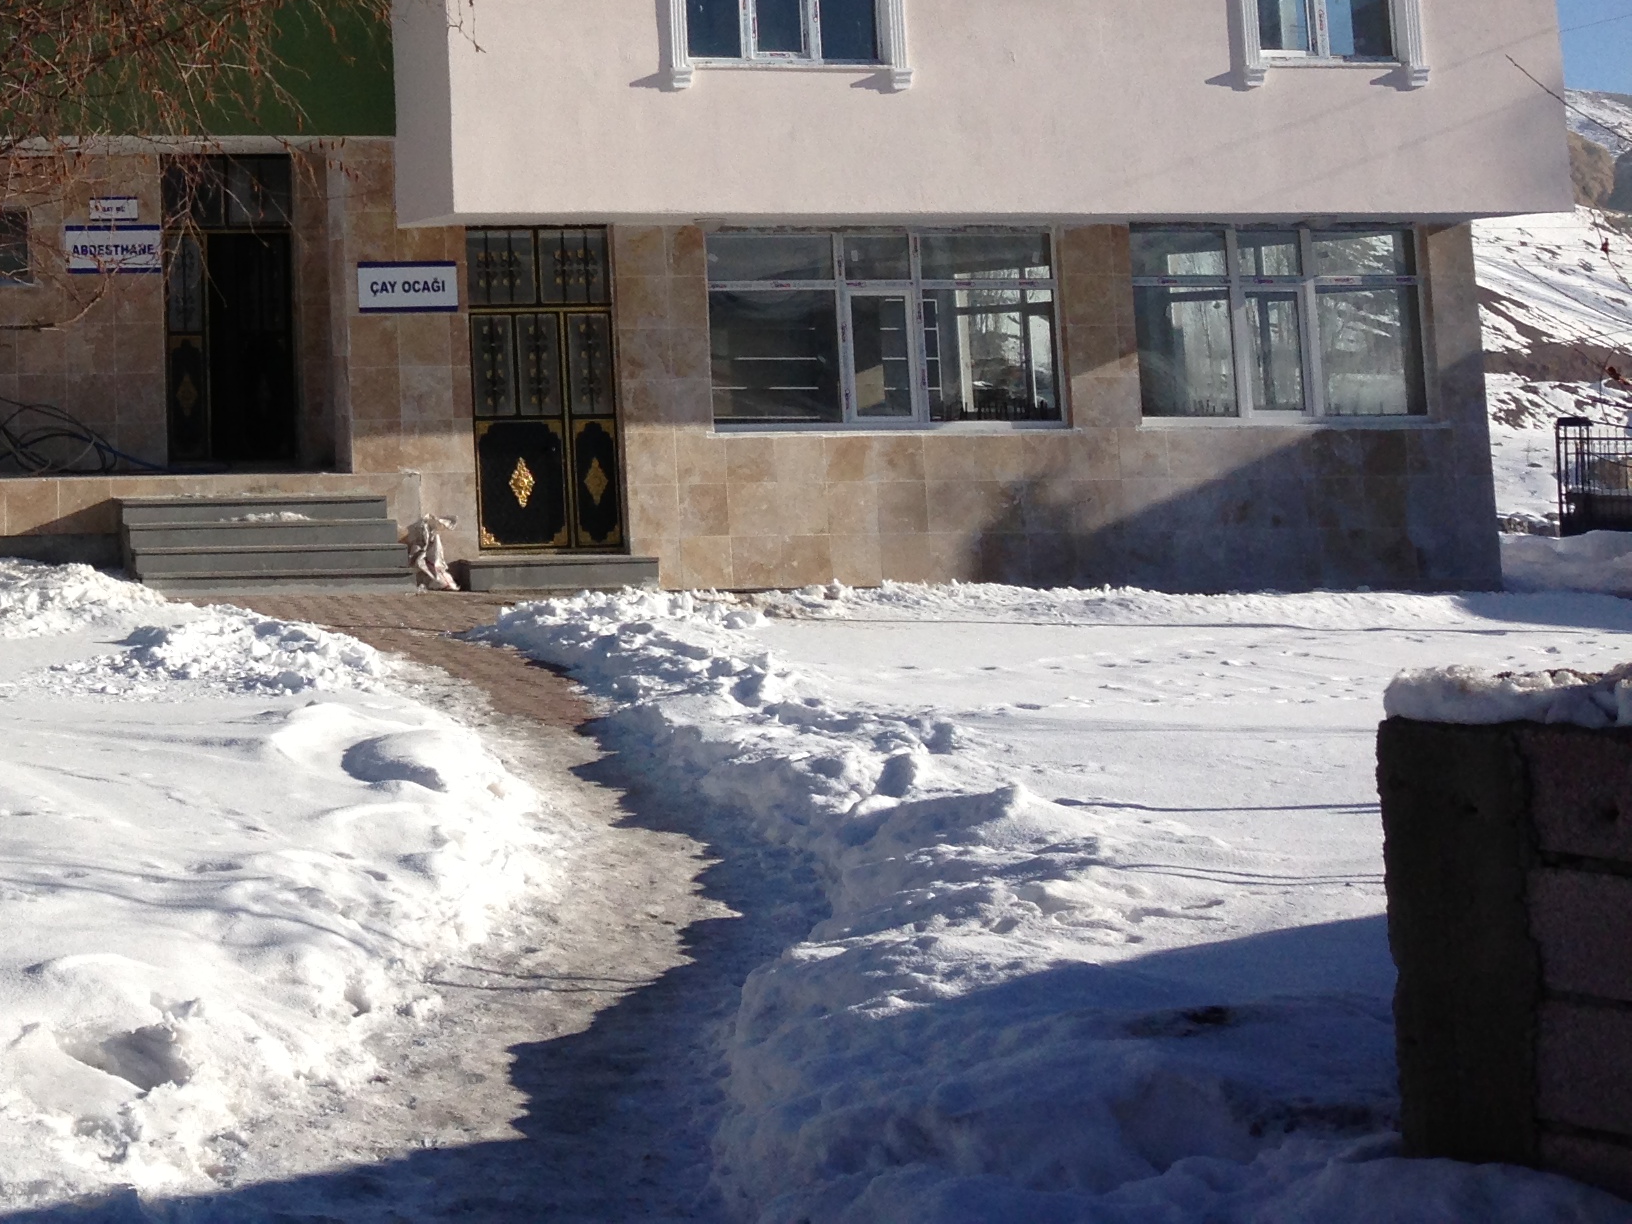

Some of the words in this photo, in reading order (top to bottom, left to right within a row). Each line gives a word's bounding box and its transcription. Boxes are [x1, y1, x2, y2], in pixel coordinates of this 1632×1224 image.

[73, 244, 154, 256] ABDESTHANE
[370, 281, 397, 296] ÇAY
[402, 277, 446, 293] OCAĞI
